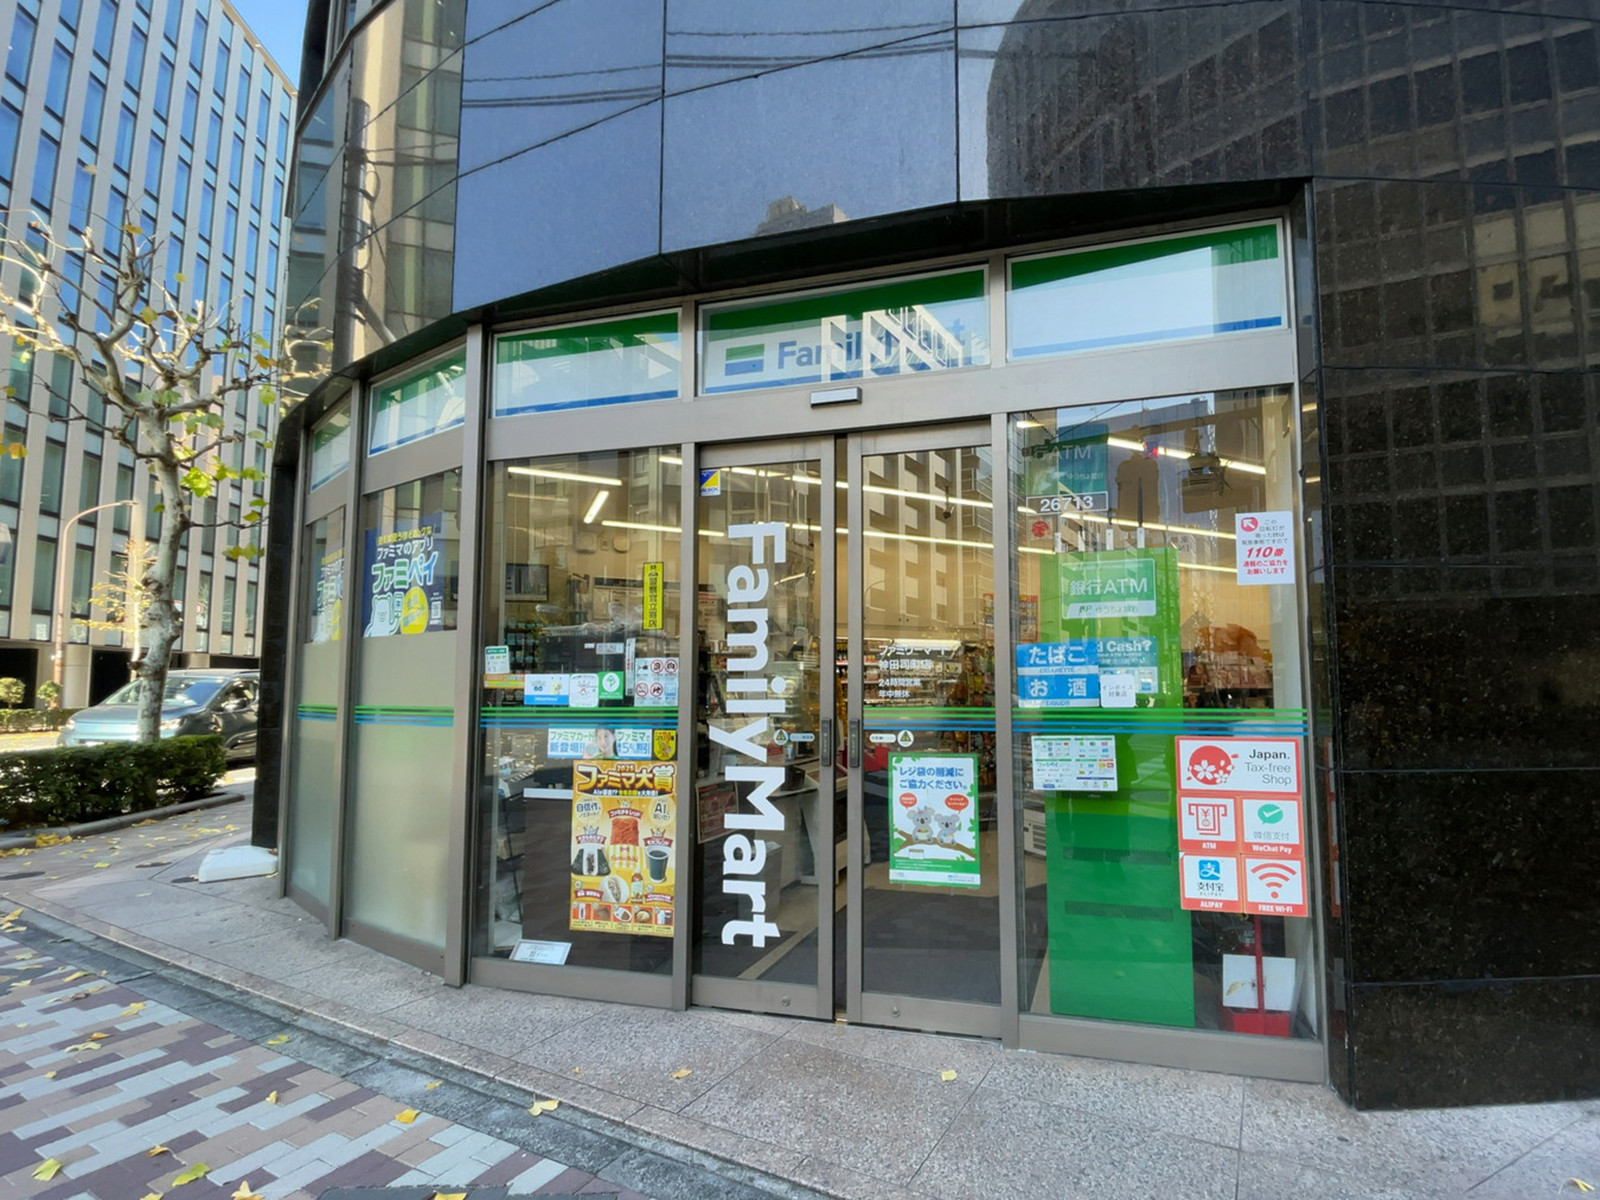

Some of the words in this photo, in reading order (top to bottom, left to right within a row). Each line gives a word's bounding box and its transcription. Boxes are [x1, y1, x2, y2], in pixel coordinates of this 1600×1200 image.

[777, 318, 967, 370] Familt
[1040, 497, 1094, 512] 26713
[376, 536, 434, 560] ファミマのアプリ
[1247, 546, 1285, 558] 110番
[371, 550, 439, 594] ファミペイ
[1246, 567, 1286, 575] お願いします
[1069, 577, 1148, 596] 銀行ATM
[1106, 640, 1152, 652] Cash?
[1029, 645, 1085, 665] たばこ
[878, 678, 922, 687] 24時間営業
[878, 690, 911, 698] 年中無休
[550, 731, 596, 741] ファミマカード
[708, 522, 787, 948] FamilyMart
[1249, 749, 1290, 761] Japan.
[899, 766, 964, 778] レジ袋の削減に
[1244, 762, 1291, 773] Tax-free
[577, 765, 674, 793] ファミマ大賞
[899, 779, 968, 790] ご協力ください。
[1262, 774, 1292, 787] Shop
[1253, 831, 1290, 841] 微信支付
[1252, 844, 1278, 853] WeChat
[1279, 846, 1292, 854] Pay
[1197, 882, 1224, 892] 支付宝
[1200, 901, 1223, 909] ALIPAY
[1258, 904, 1274, 912] FREE
